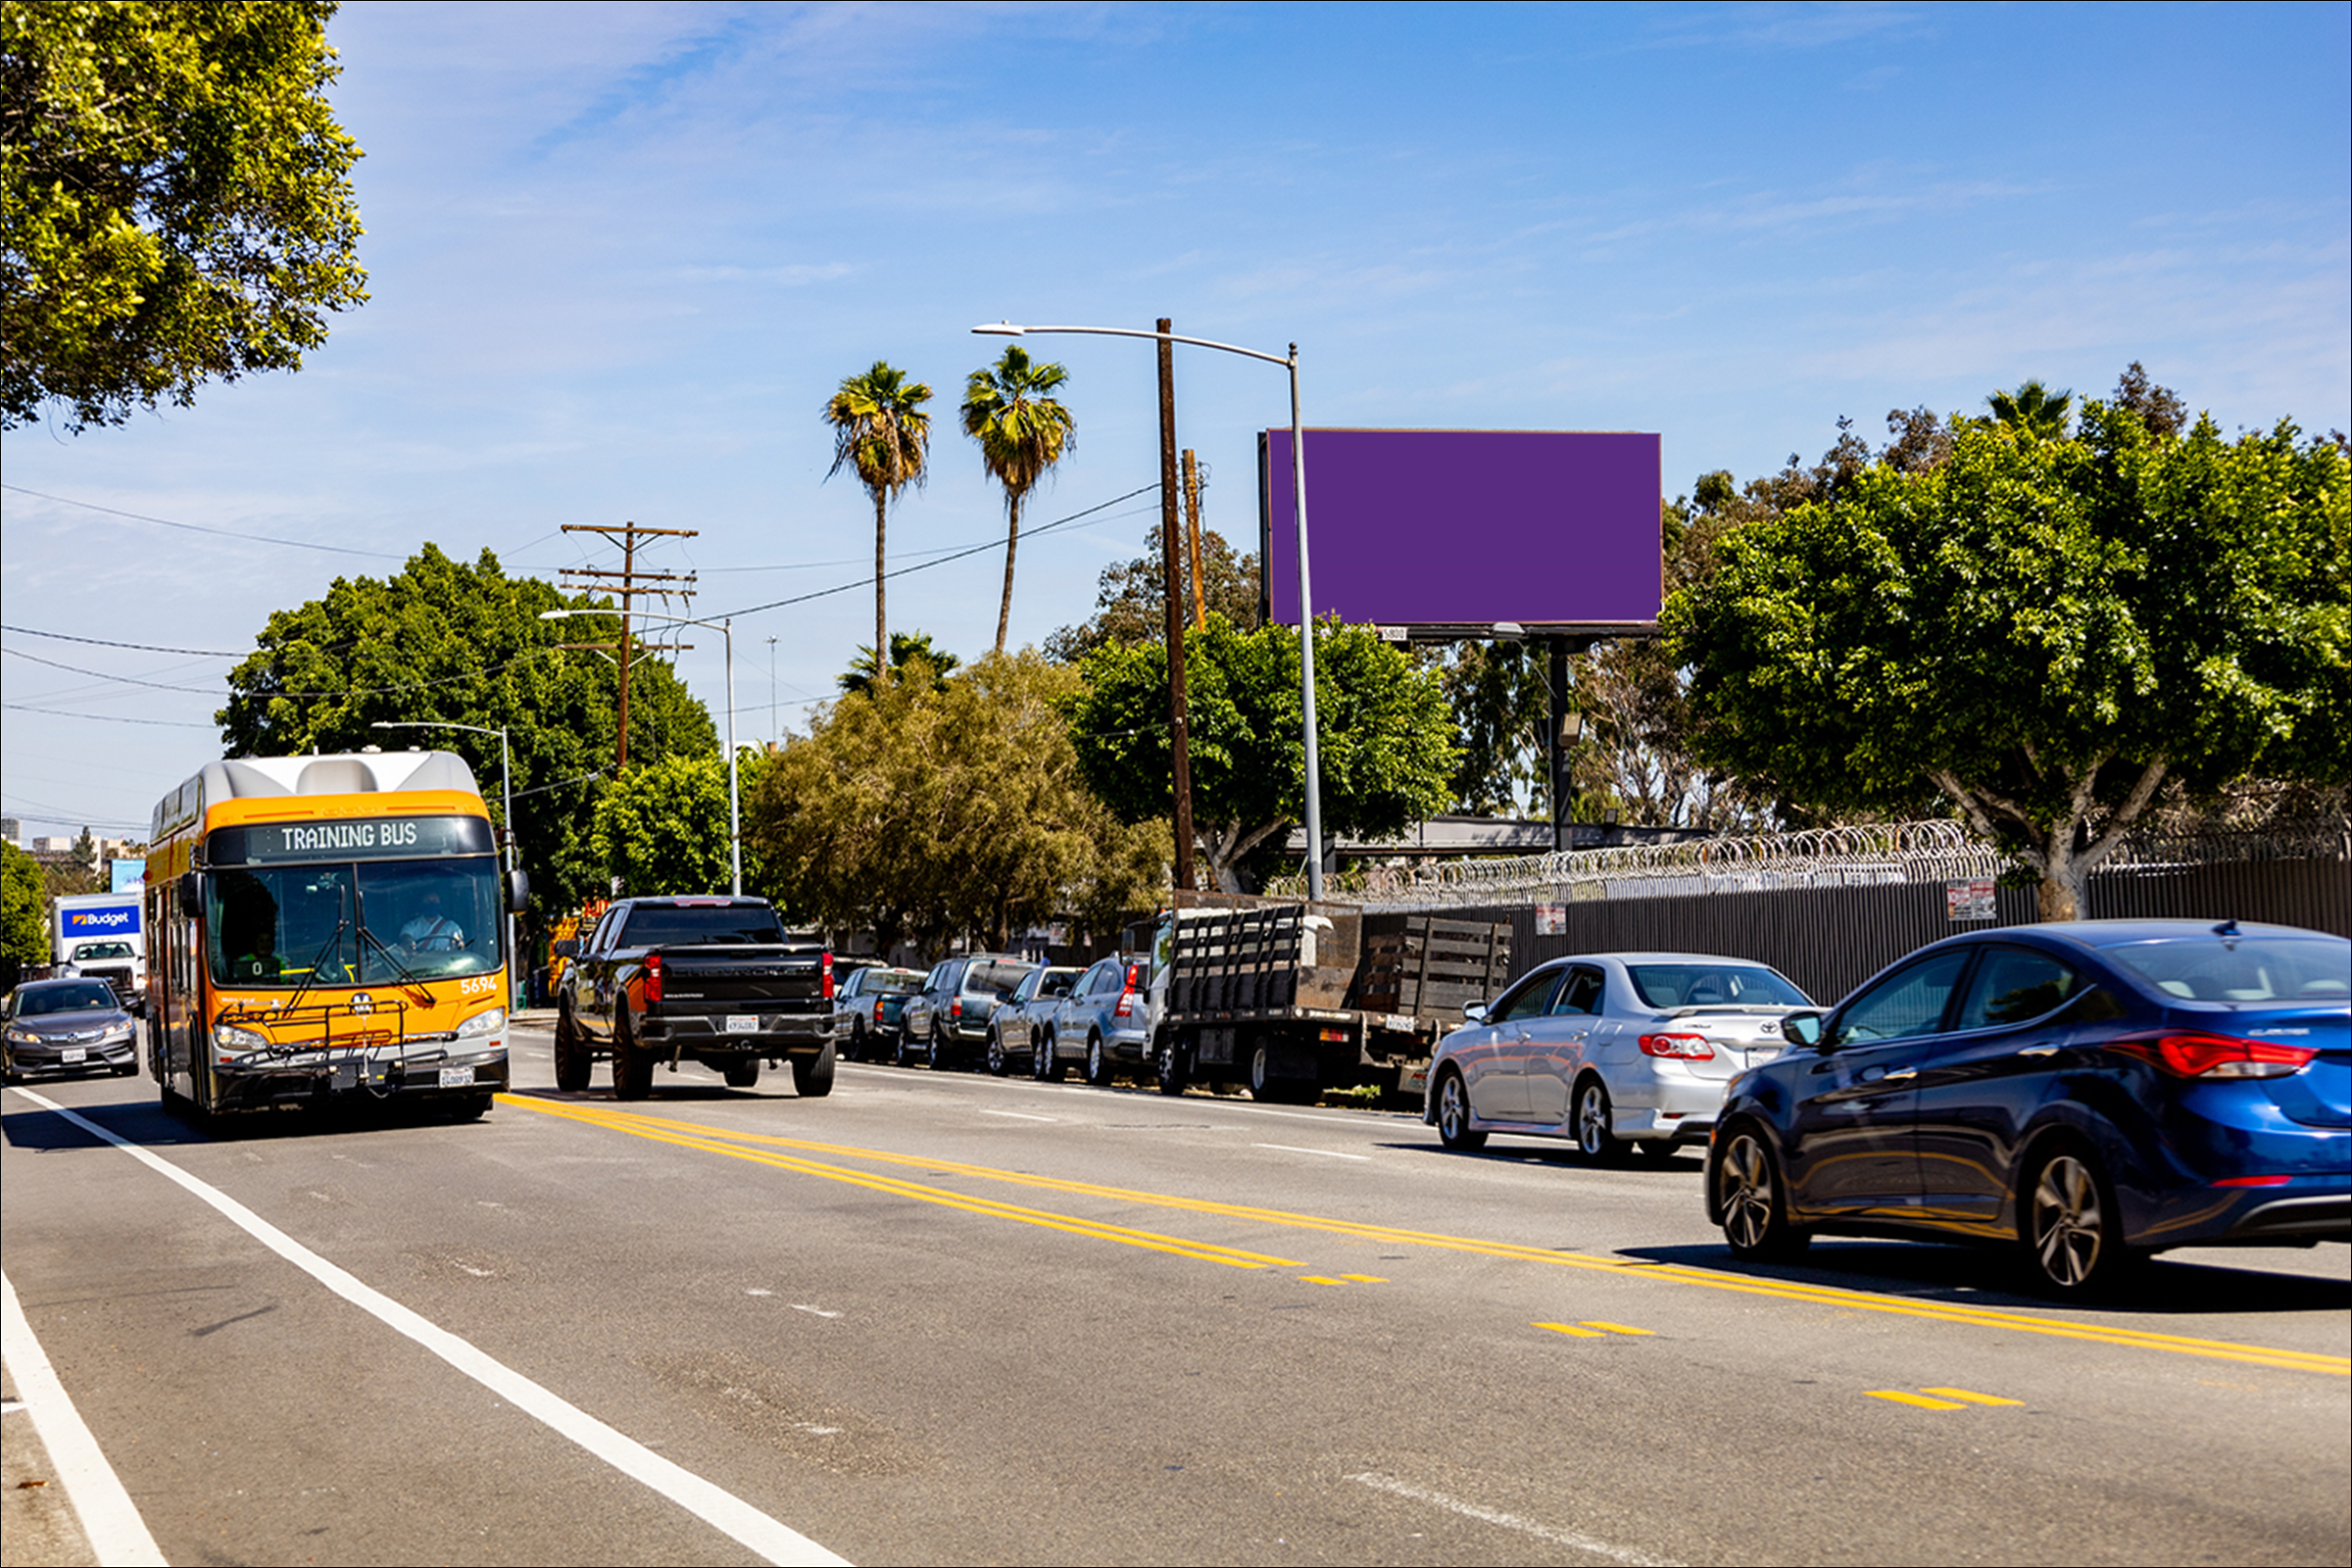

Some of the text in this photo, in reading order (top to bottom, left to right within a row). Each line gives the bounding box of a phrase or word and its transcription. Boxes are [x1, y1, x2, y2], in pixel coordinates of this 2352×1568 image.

[281, 822, 417, 851] TRAINING BUS
[87, 912, 129, 927] Budget
[252, 961, 263, 976] 0
[461, 976, 497, 995] 5694
